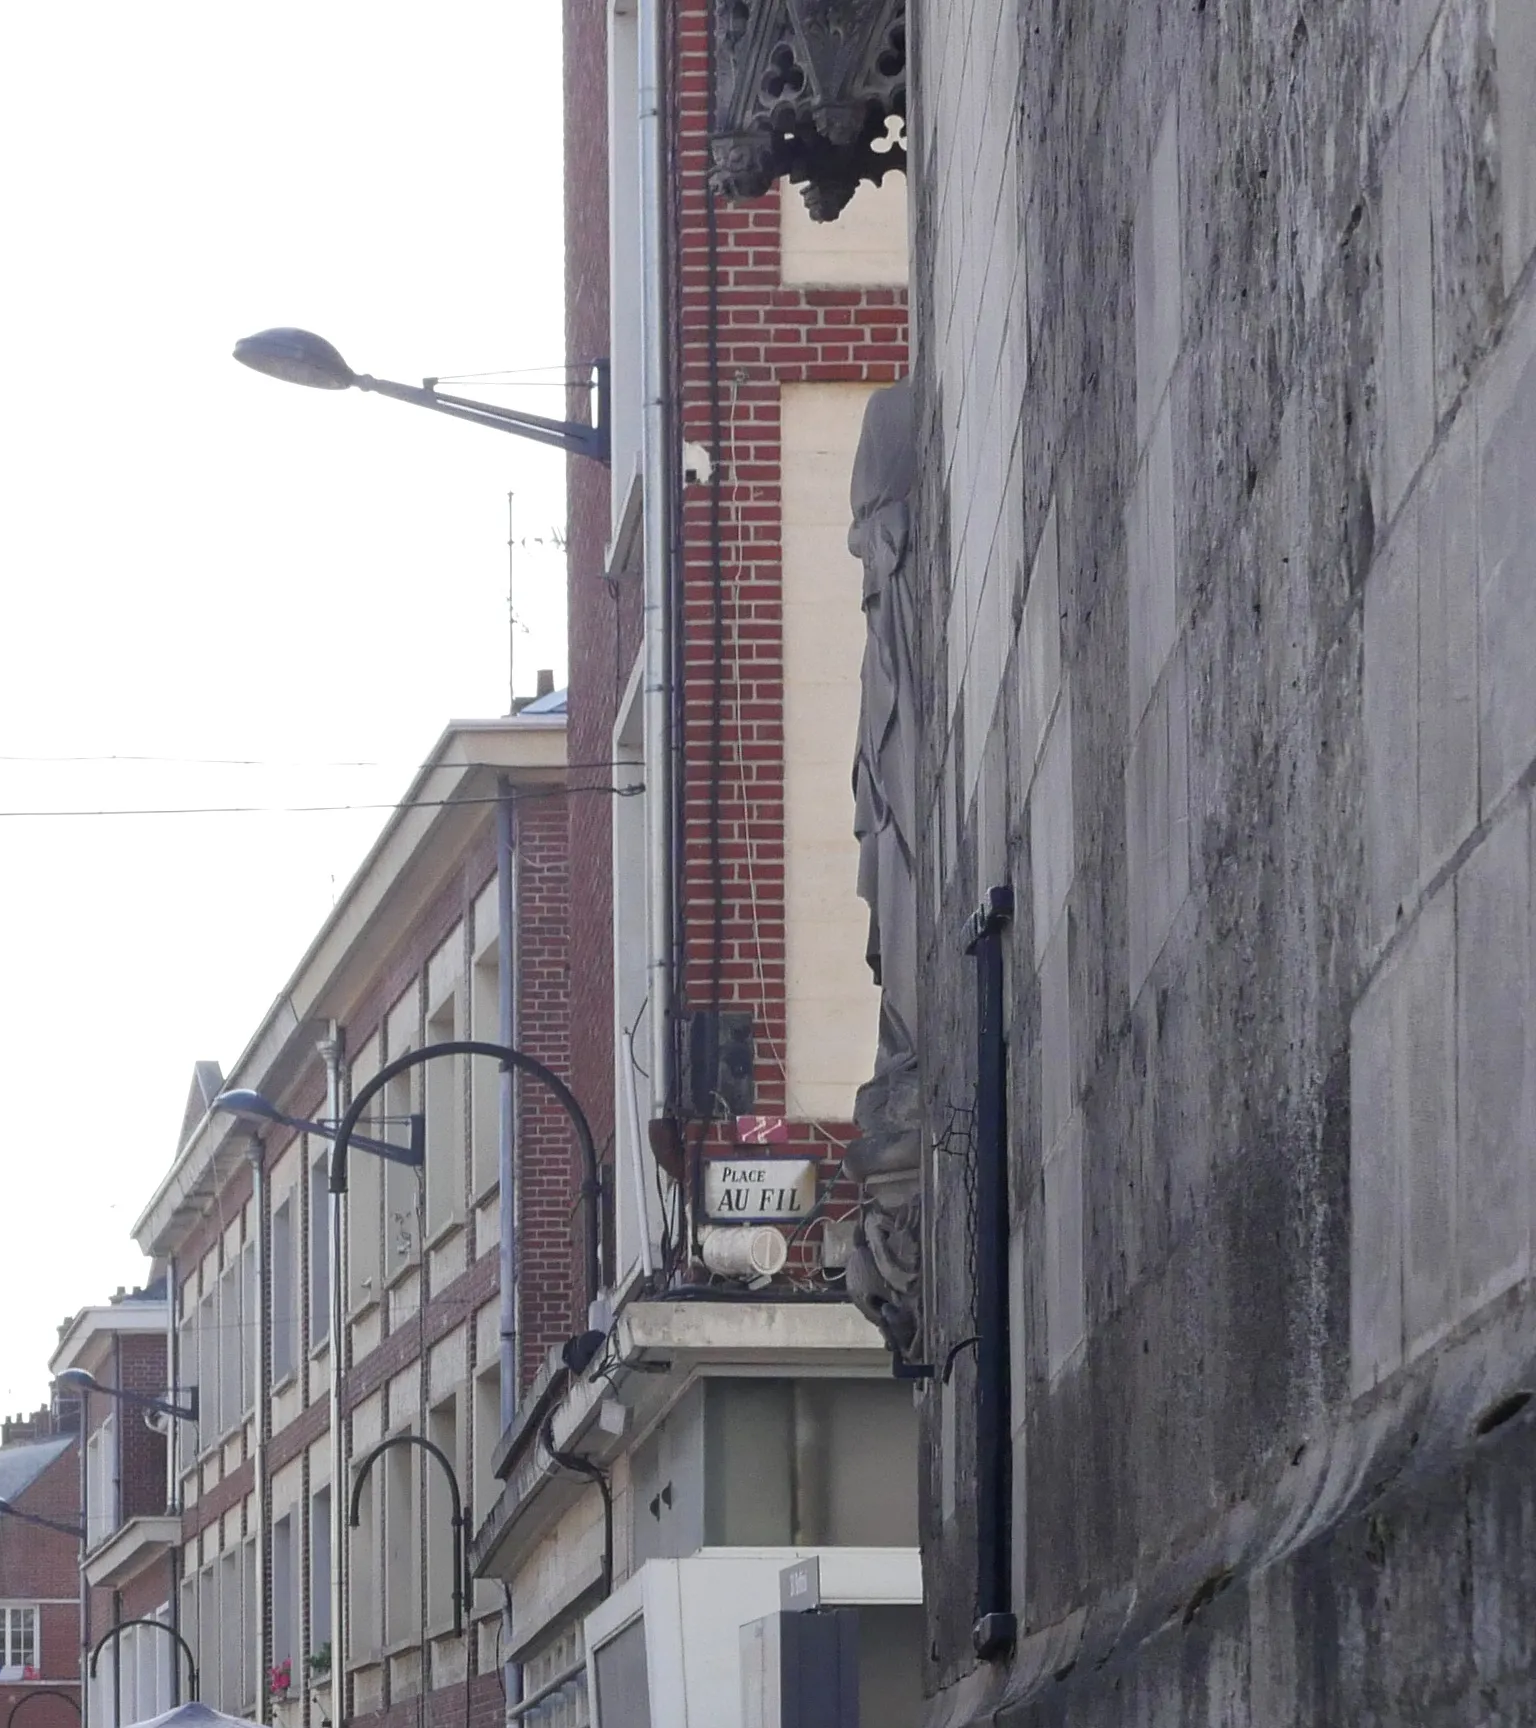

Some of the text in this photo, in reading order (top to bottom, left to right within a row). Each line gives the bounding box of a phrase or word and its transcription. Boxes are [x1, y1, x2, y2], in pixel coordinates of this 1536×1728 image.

[722, 1166, 766, 1183] PLACE
[717, 1188, 801, 1212] AU FIL
